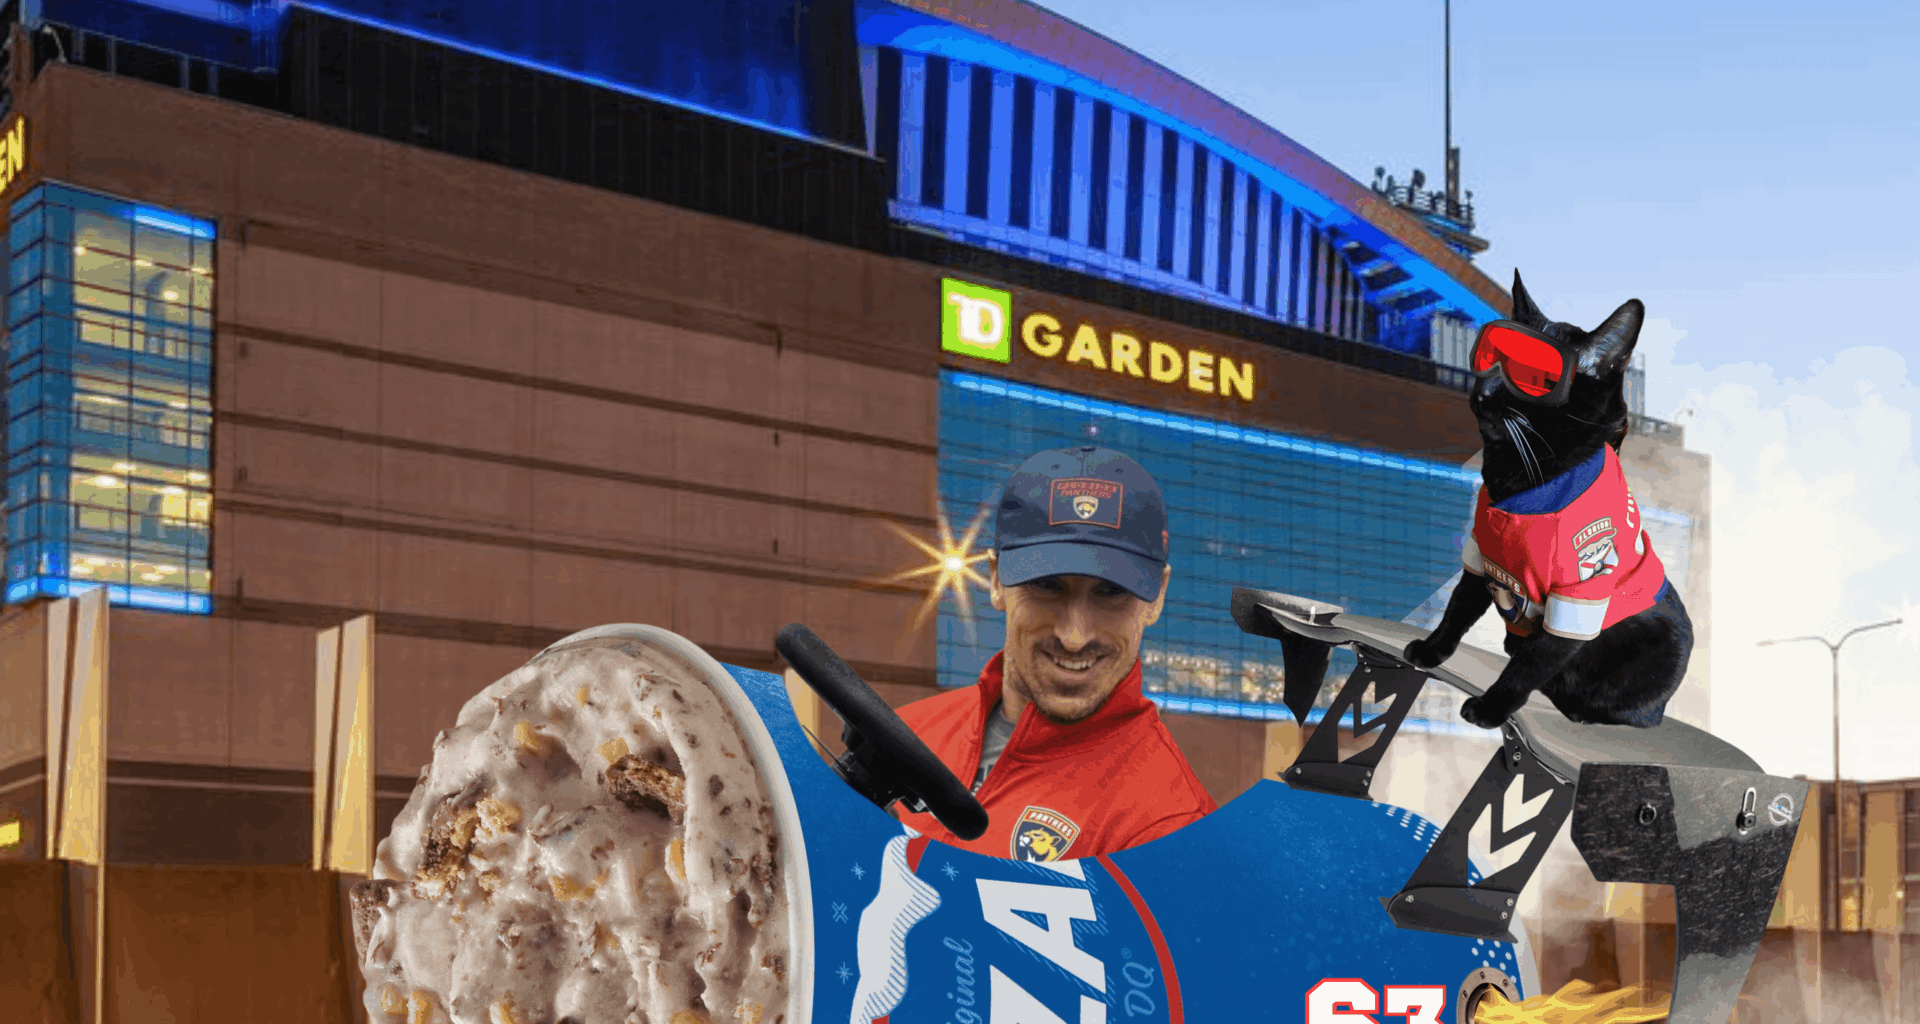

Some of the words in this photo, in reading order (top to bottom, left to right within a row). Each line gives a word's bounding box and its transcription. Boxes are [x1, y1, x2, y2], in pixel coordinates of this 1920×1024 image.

[946, 291, 1006, 350] TD
[1021, 313, 1254, 401] GARDEN
[1484, 561, 1521, 593] ANTHERS
[1028, 811, 1073, 838] PANTHERS
